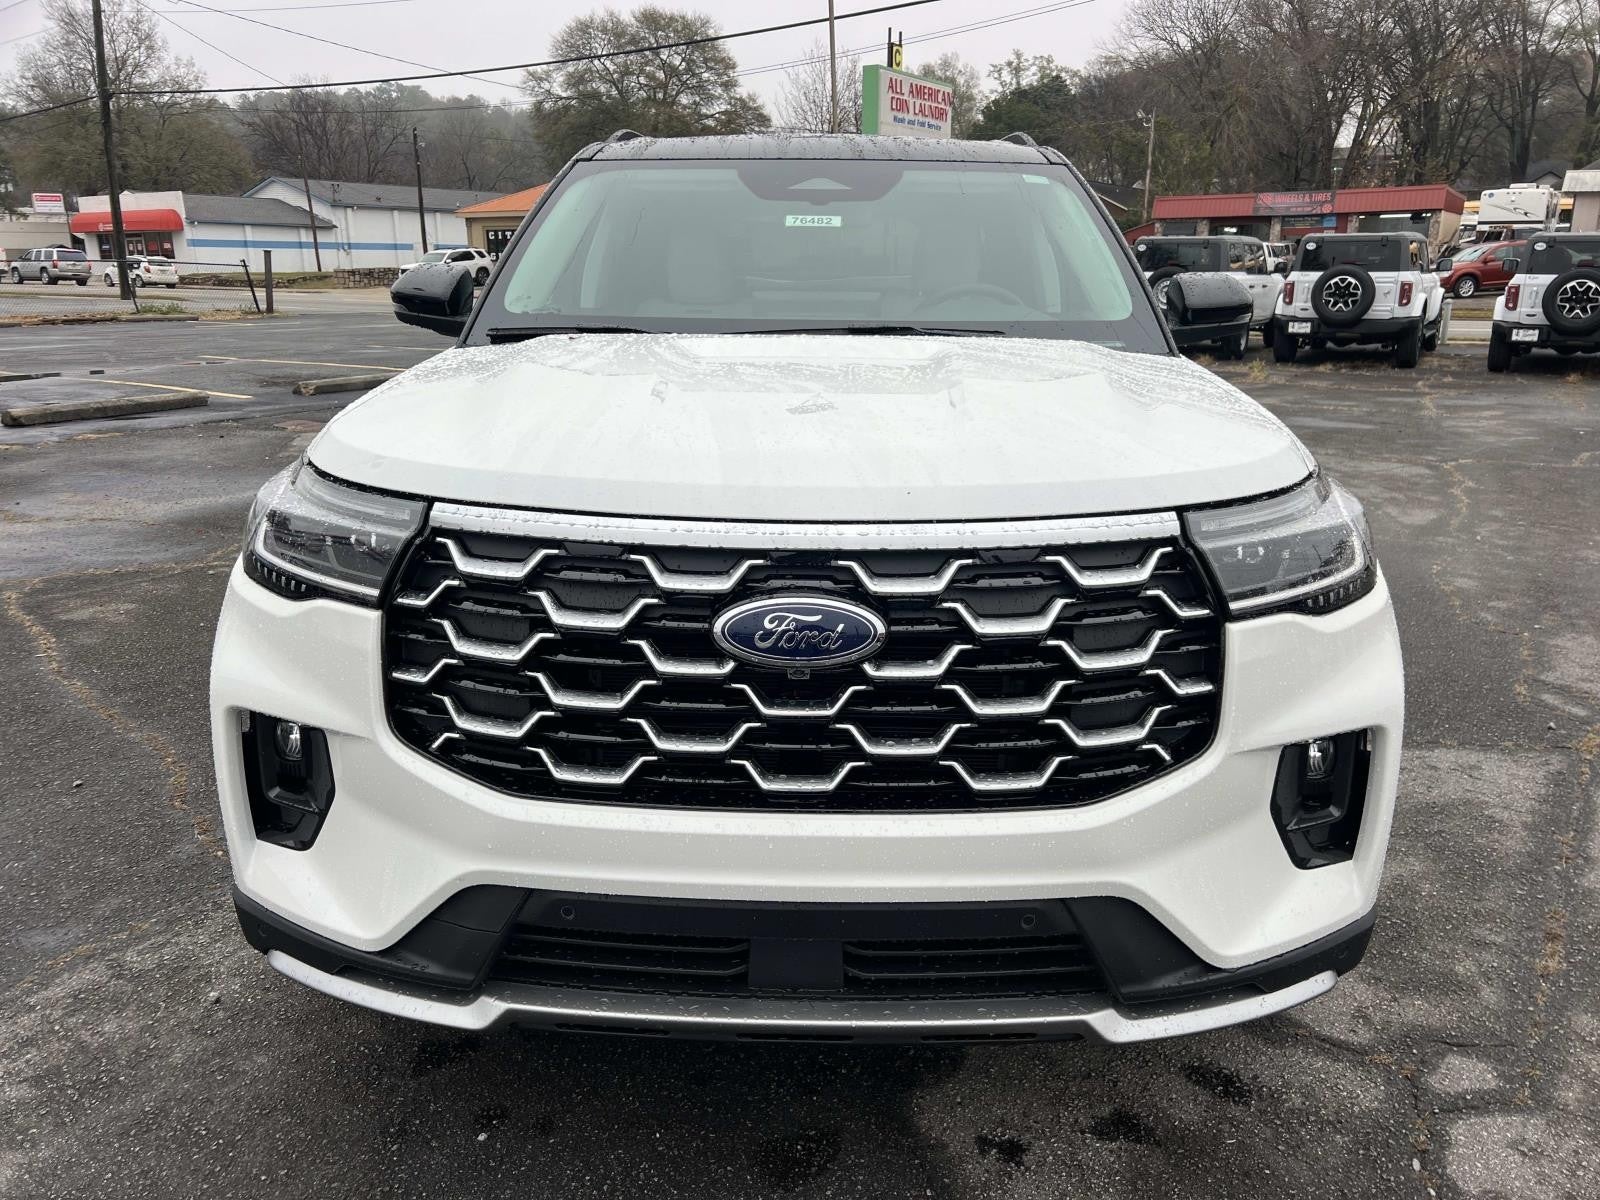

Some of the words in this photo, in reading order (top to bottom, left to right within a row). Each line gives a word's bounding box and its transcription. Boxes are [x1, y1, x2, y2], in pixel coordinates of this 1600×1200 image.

[887, 77, 905, 96] ALL
[909, 82, 955, 107] AMERICAN
[891, 96, 910, 114] COIN
[913, 101, 949, 122] LAUNDRY
[907, 118, 915, 126] and
[927, 121, 942, 131] Service
[1277, 193, 1303, 202] WHEELS
[1304, 194, 1310, 202] &
[1311, 192, 1332, 202] TIRES
[791, 217, 833, 225] 76482
[754, 612, 845, 649] Ford
